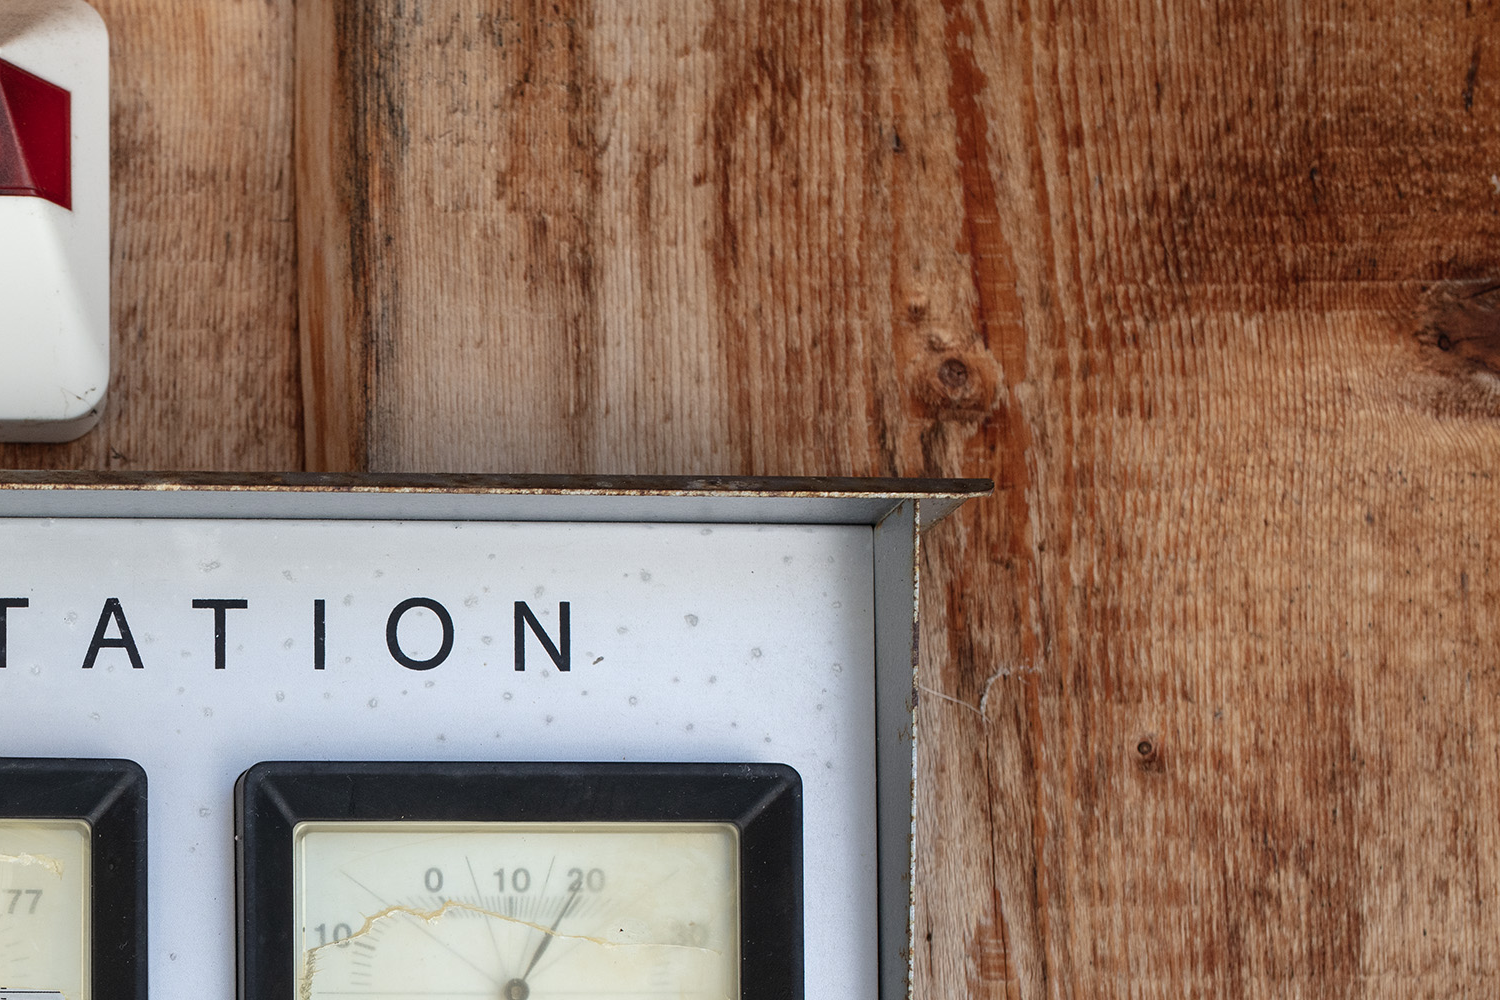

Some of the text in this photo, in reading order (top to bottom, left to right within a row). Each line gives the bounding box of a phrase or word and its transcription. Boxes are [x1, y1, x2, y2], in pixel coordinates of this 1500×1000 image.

[424, 867, 444, 893] 0
[492, 868, 531, 892] 10
[566, 867, 606, 892] 20
[5, 889, 43, 914] 77
[314, 923, 352, 949] 10
